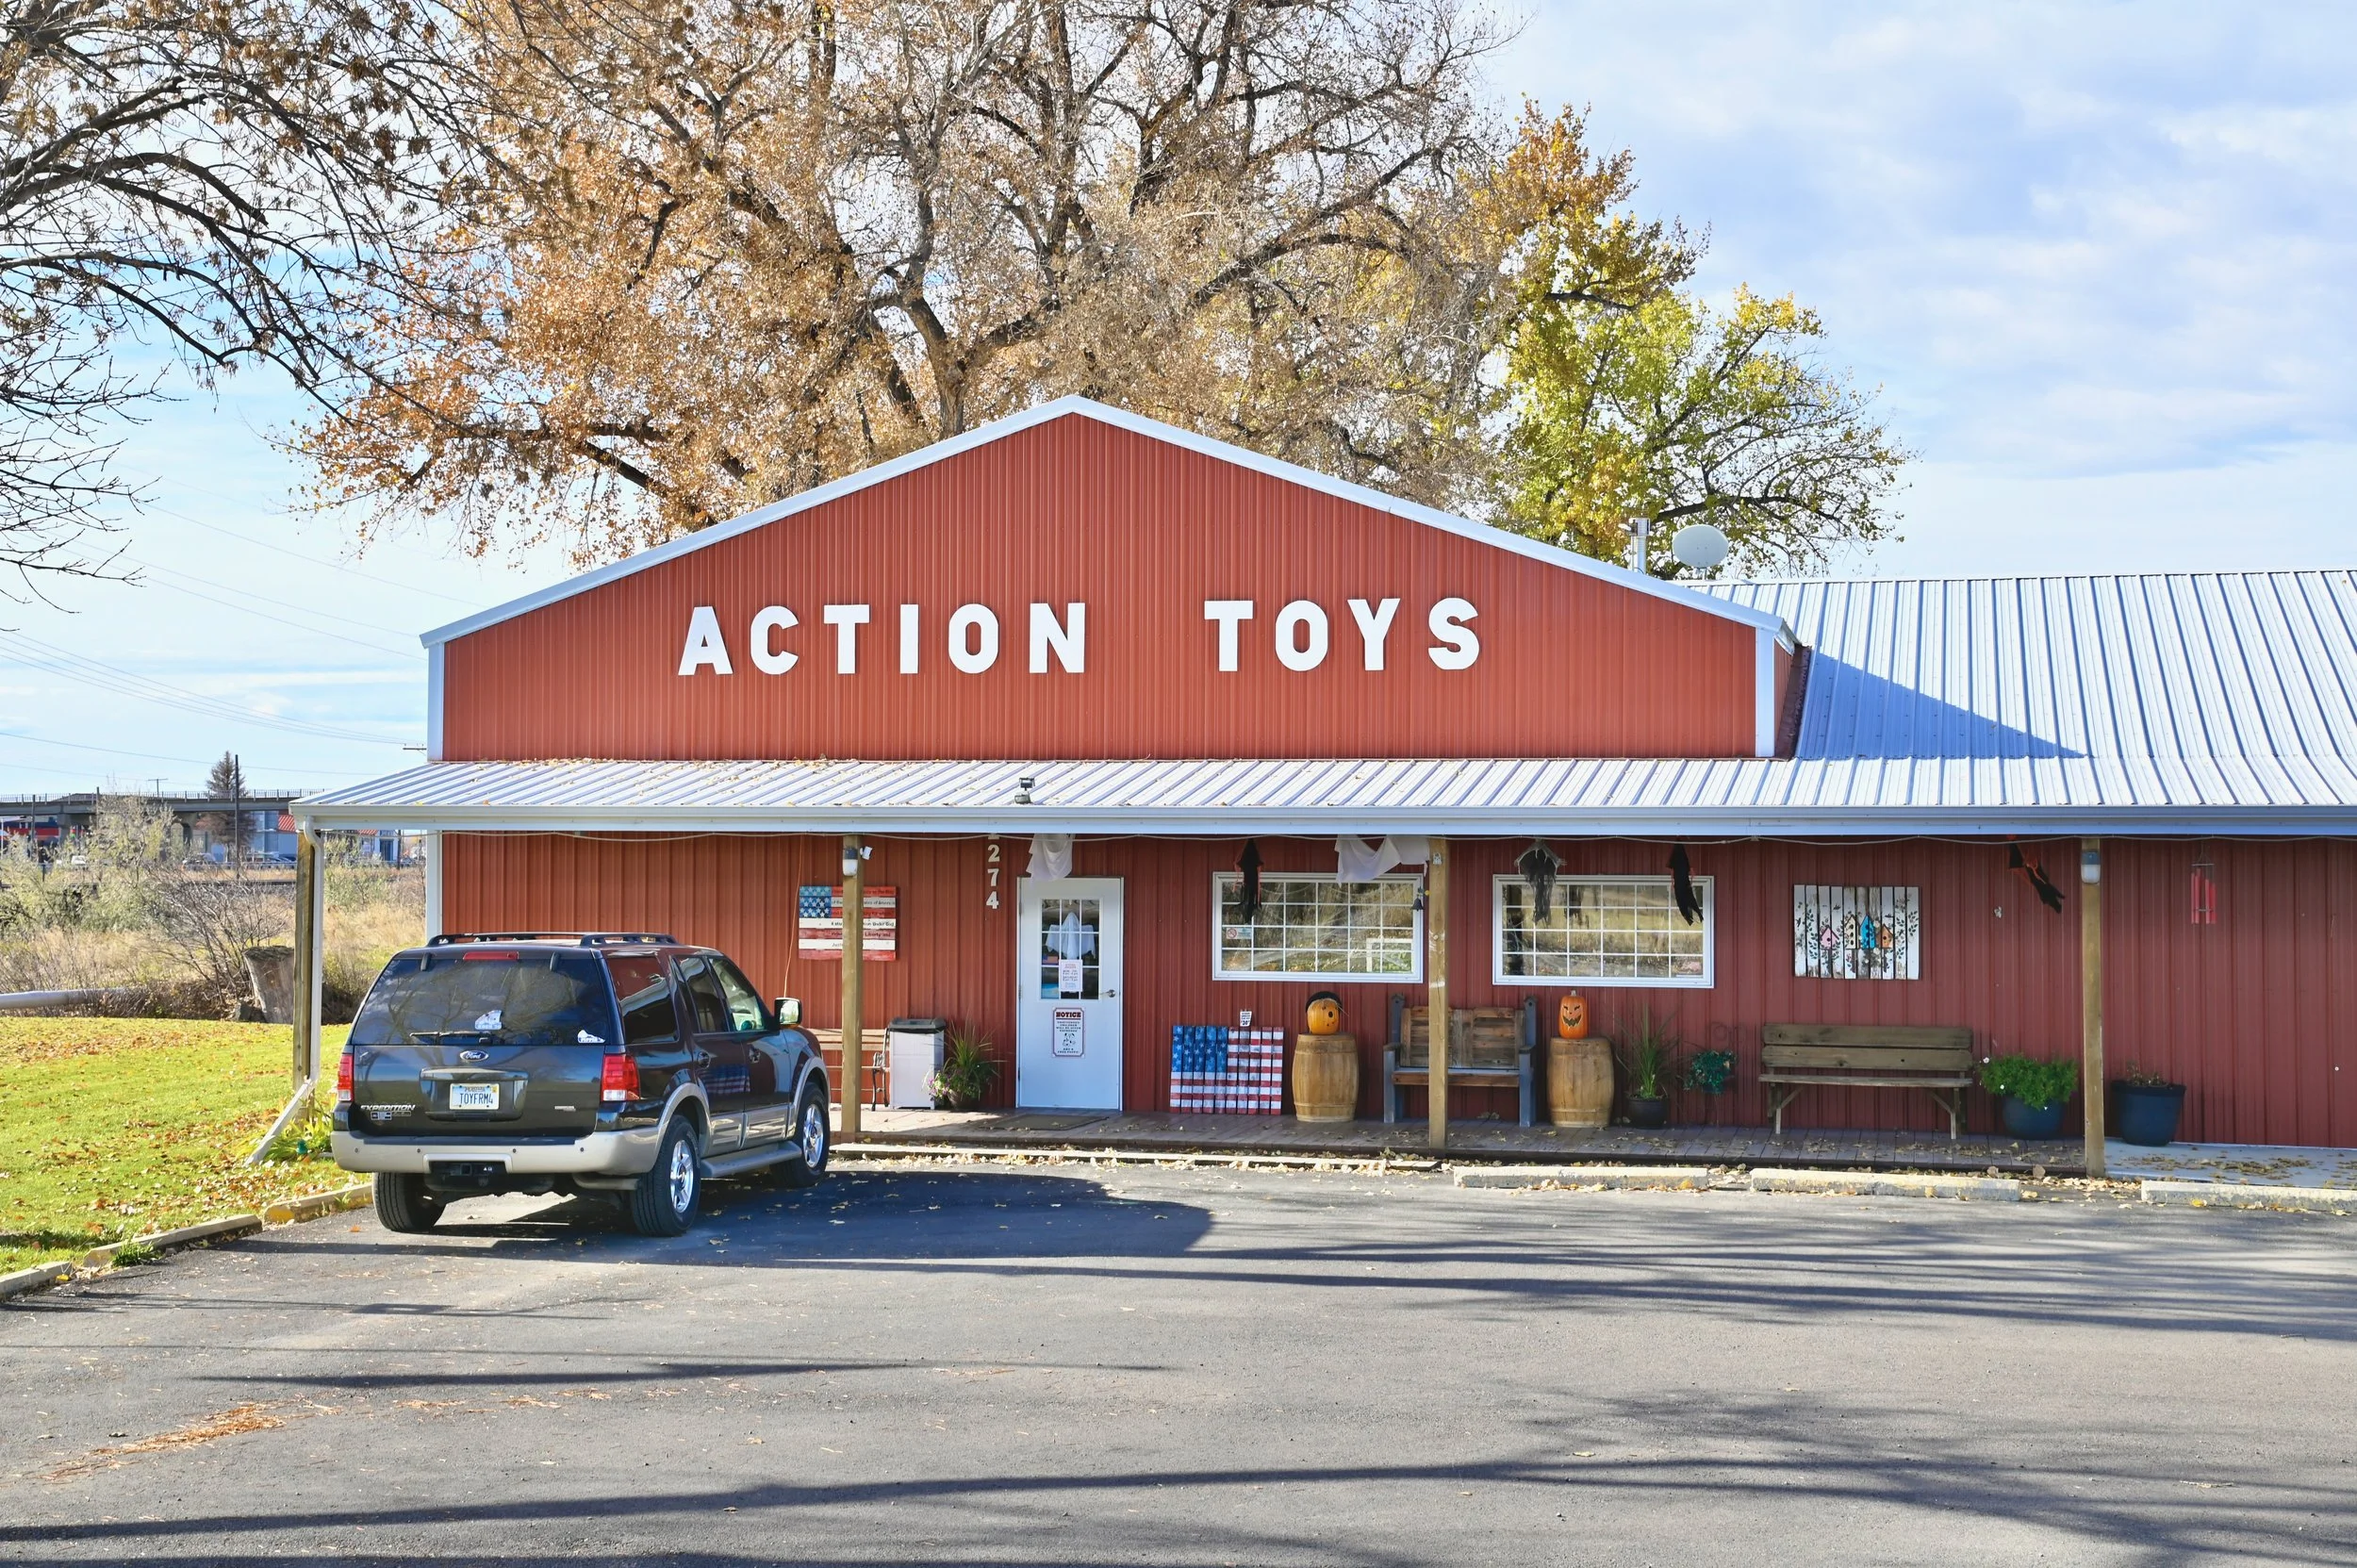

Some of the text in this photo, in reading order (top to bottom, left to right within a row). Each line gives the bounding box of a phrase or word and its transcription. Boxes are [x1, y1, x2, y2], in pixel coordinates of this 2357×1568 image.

[678, 597, 1480, 676] ACTION TOYS
[986, 834, 1000, 910] 274
[459, 1093, 493, 1105] TOYFRM4
